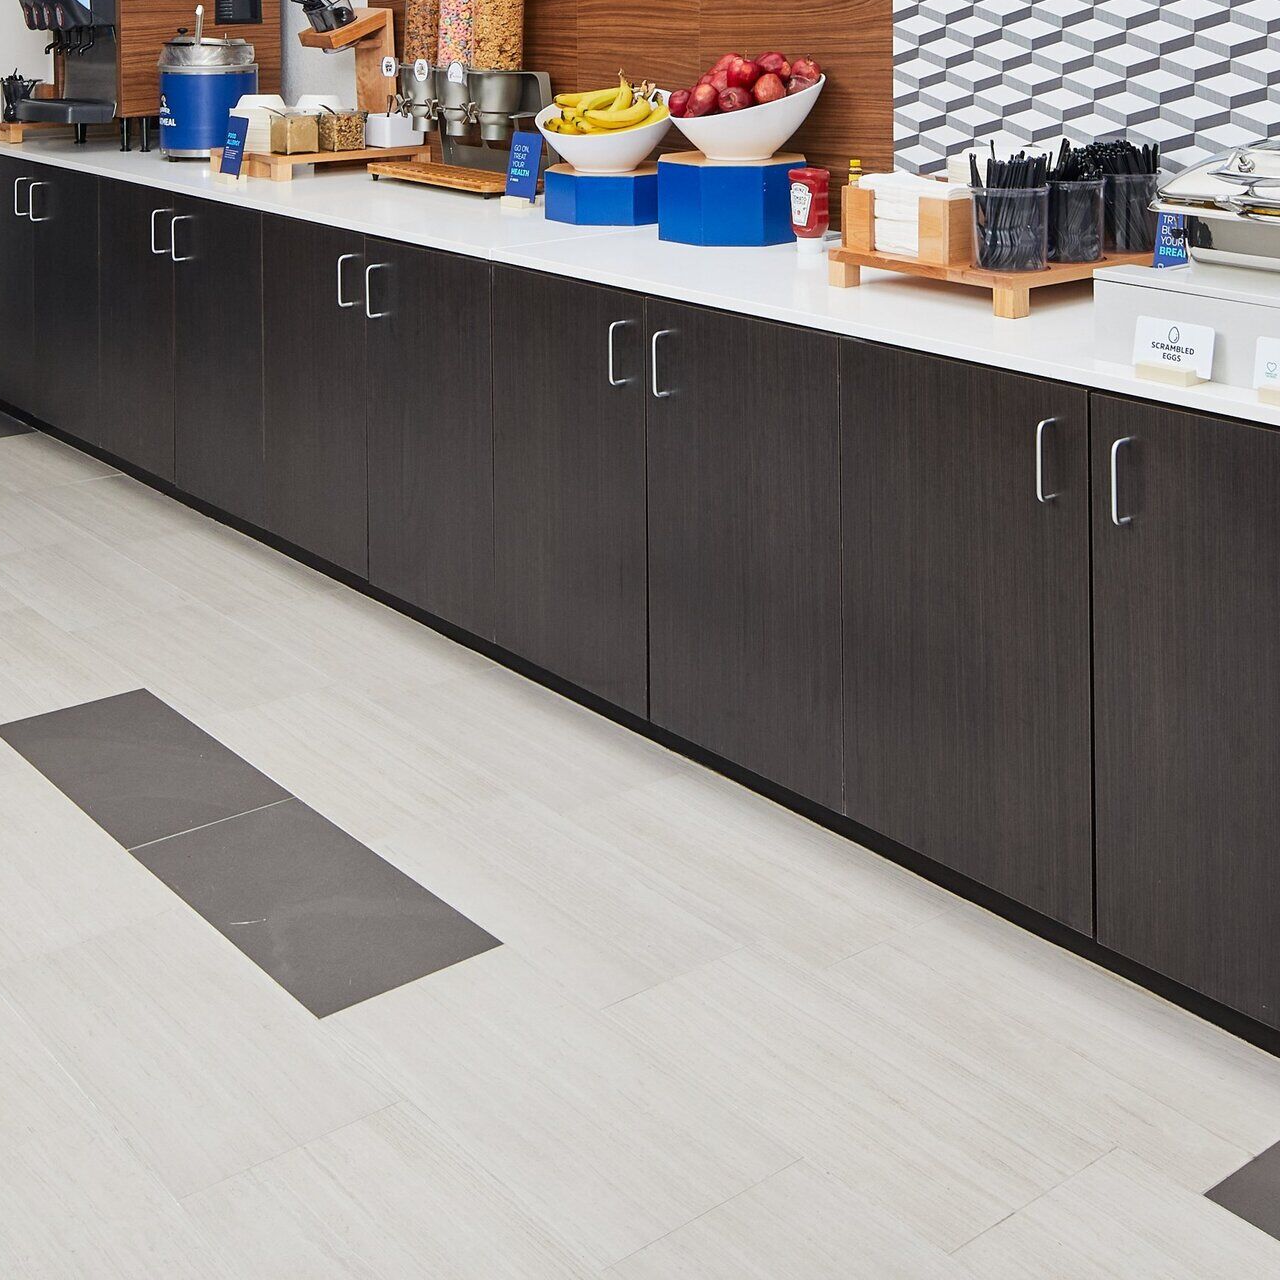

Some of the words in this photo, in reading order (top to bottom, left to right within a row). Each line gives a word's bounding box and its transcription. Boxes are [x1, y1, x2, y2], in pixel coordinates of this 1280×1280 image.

[513, 144, 521, 152] GO
[513, 152, 527, 160] TREAT
[512, 160, 525, 168] YOUR
[510, 167, 530, 177] HEALTH
[1161, 236, 1184, 247] YOUR
[1151, 341, 1195, 356] SCRAMBLED
[1162, 352, 1181, 362] EGGS
